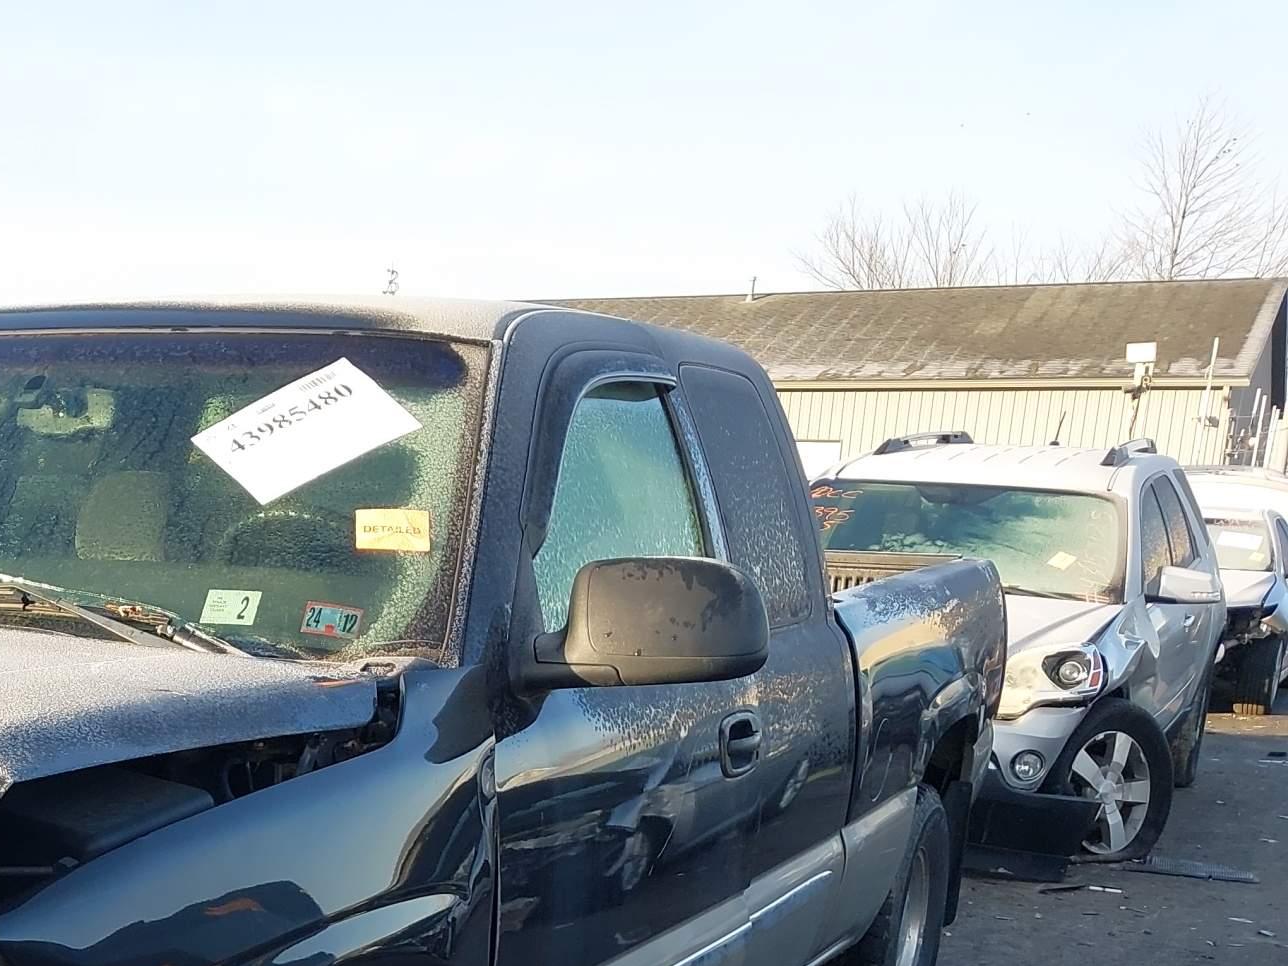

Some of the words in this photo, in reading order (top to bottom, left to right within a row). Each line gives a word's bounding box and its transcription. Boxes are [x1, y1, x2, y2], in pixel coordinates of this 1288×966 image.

[230, 383, 353, 453] 43985480
[363, 525, 421, 535] DETAILED
[237, 596, 250, 619] 2
[306, 607, 322, 628] 24
[342, 613, 358, 633] 12
